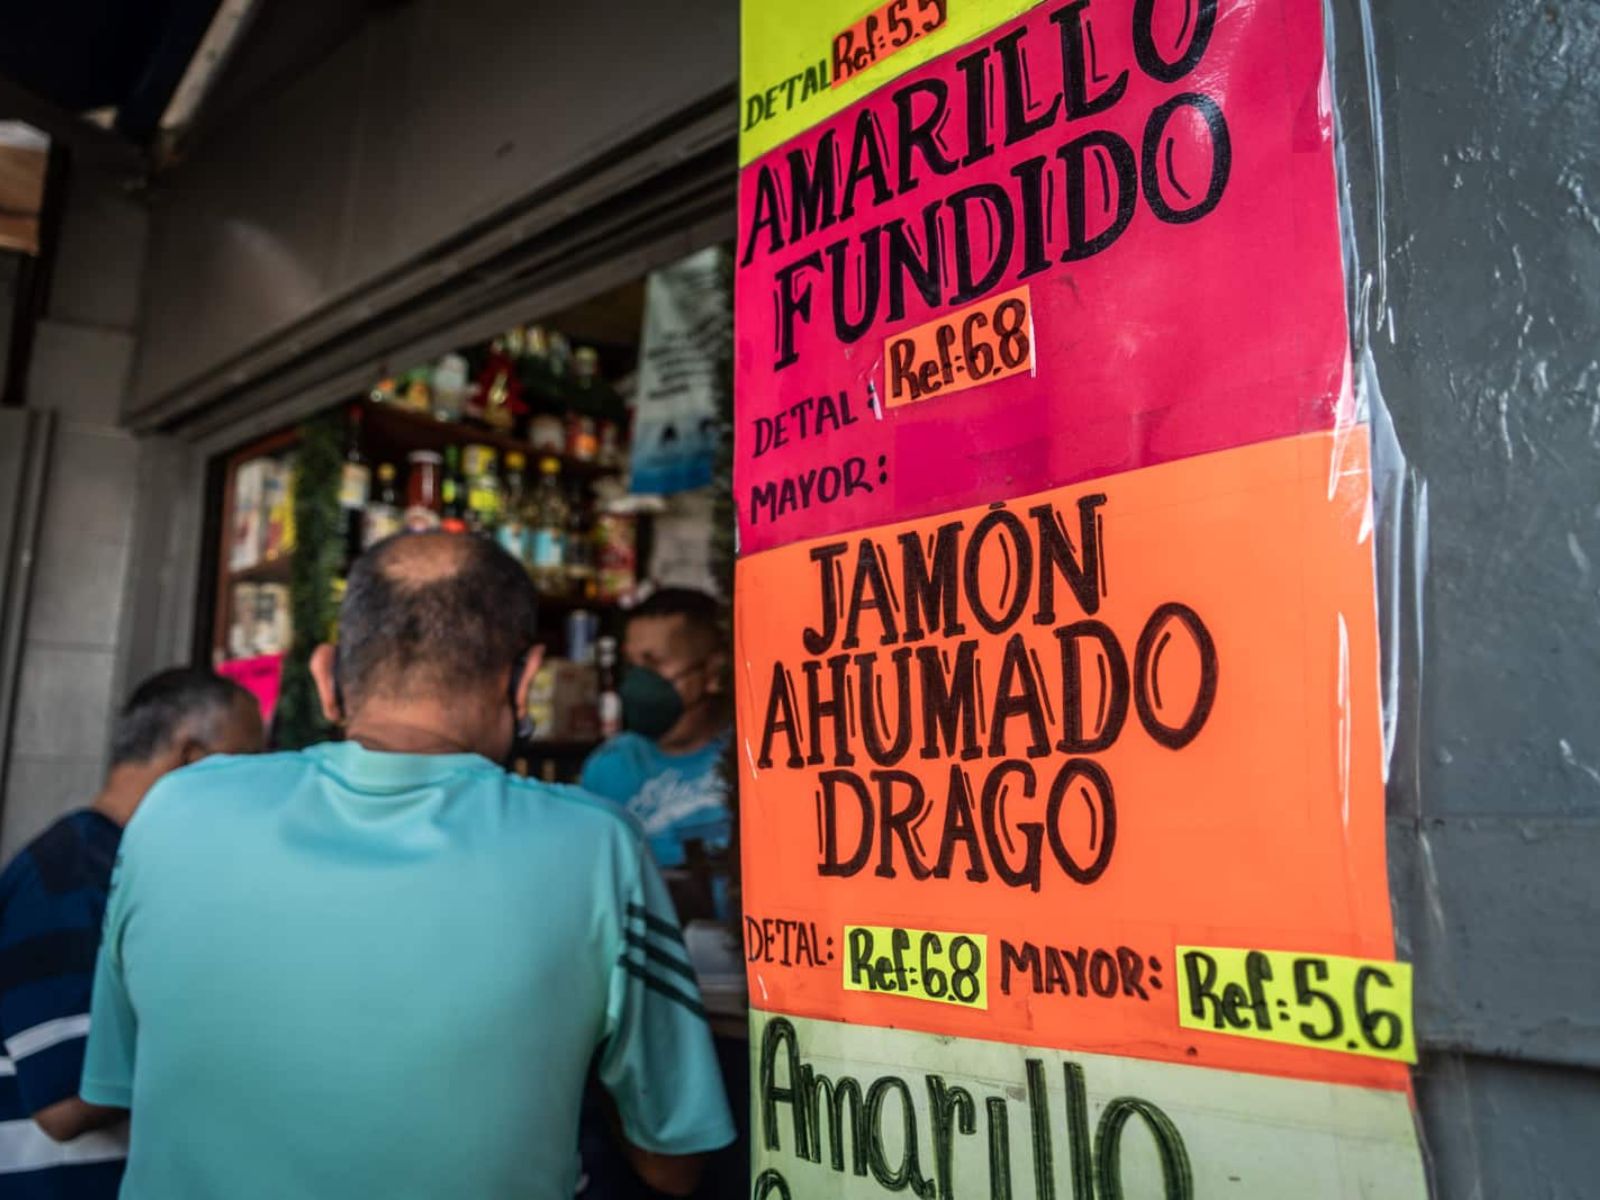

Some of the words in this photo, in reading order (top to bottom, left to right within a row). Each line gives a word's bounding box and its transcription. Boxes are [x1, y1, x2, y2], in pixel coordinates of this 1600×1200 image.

[741, 0, 1217, 268] AMARILLO
[744, 59, 832, 132] DETAL
[773, 92, 1232, 371] FUNDIDO
[750, 454, 887, 525] MAYOR:
[757, 602, 1219, 769] AHUMADO
[816, 758, 1116, 893] DRAGO
[745, 916, 834, 968] DETAL:
[1000, 940, 1162, 1000] MAYOR:
[759, 1016, 1194, 1200] Amarillo
